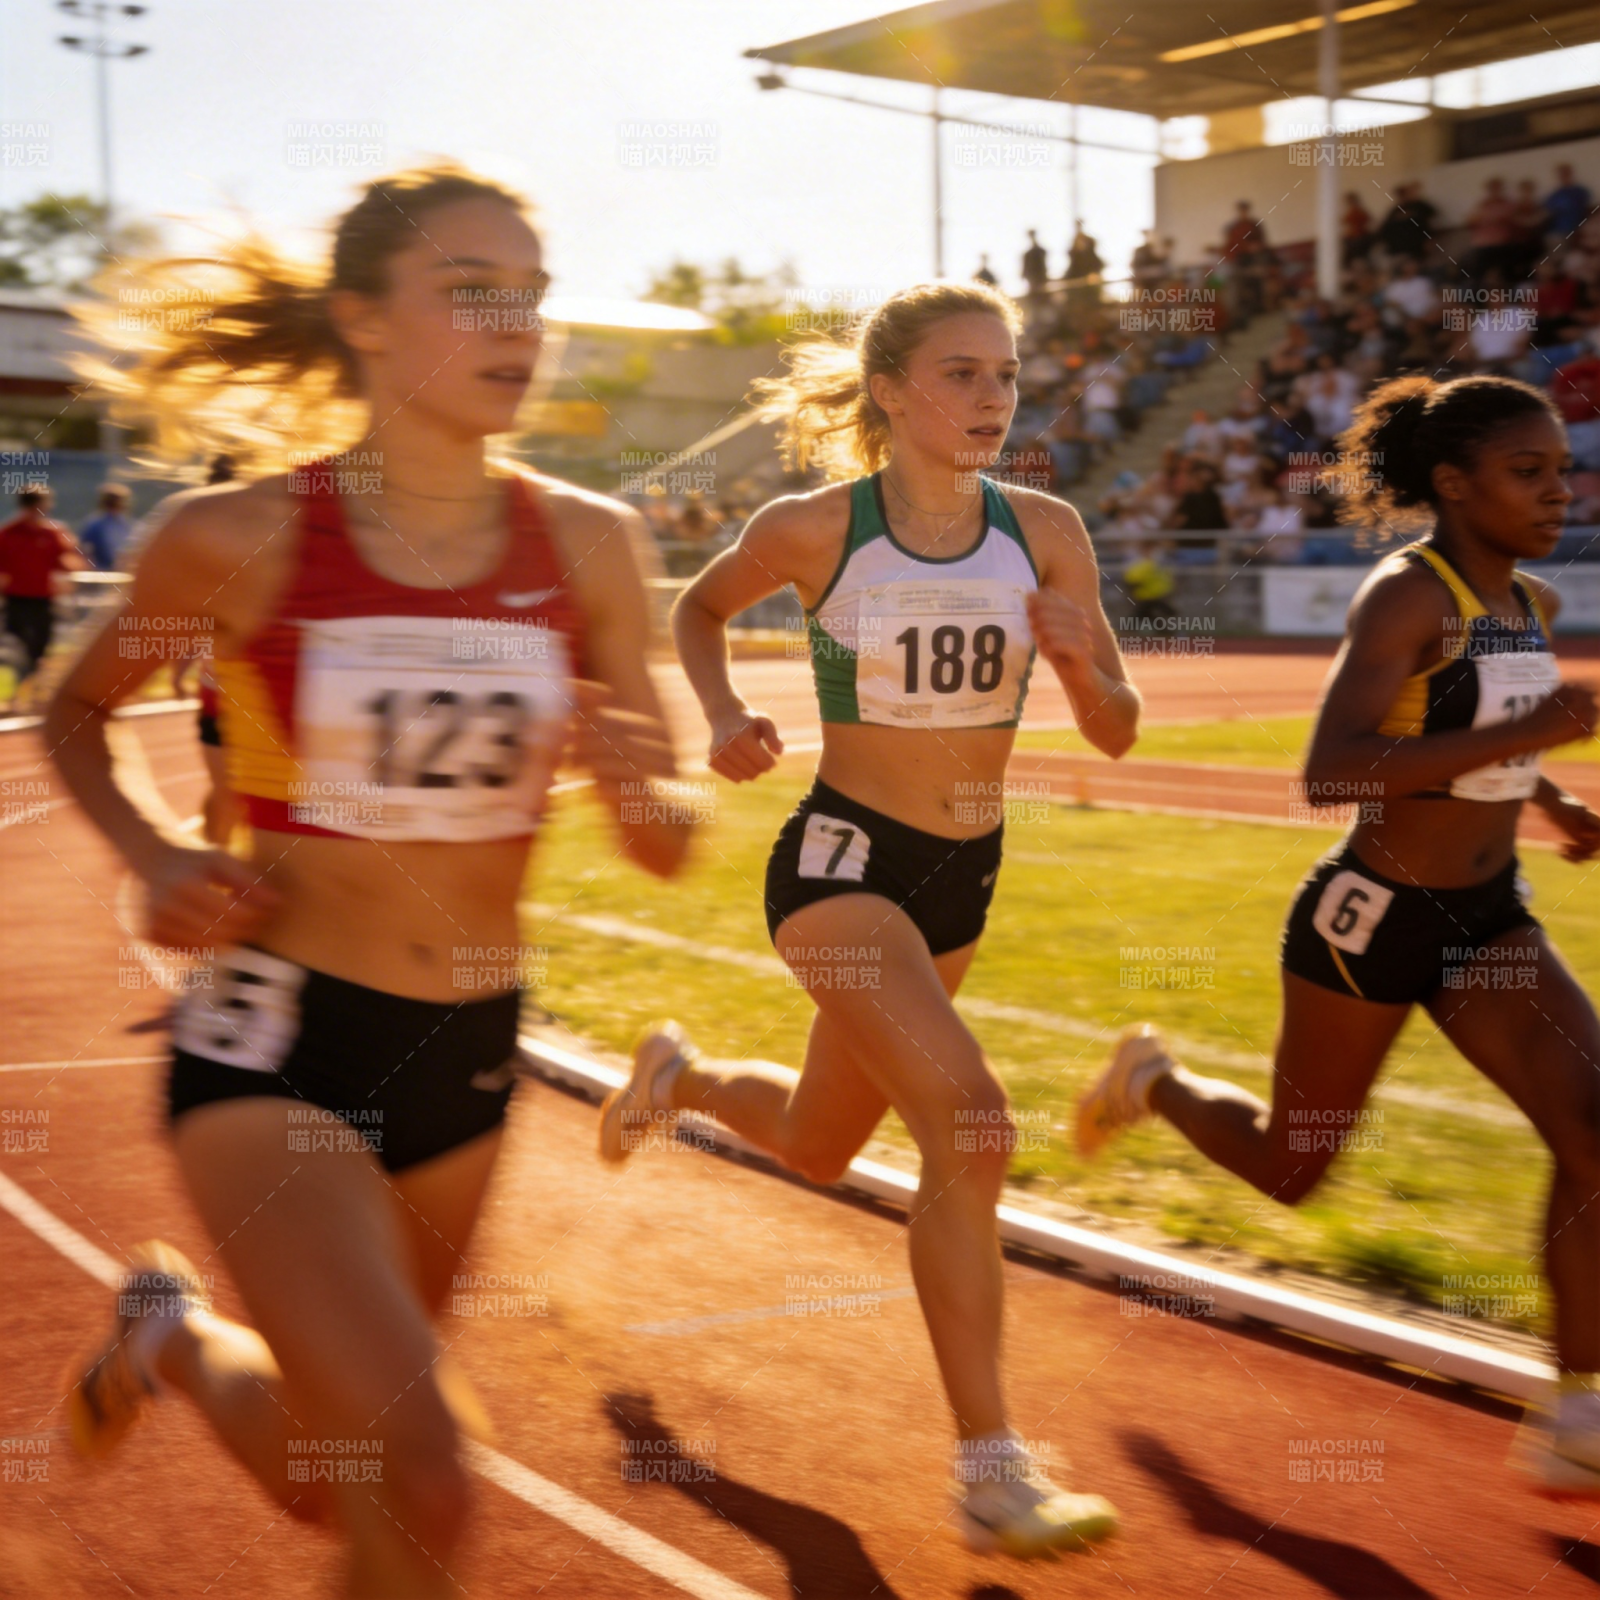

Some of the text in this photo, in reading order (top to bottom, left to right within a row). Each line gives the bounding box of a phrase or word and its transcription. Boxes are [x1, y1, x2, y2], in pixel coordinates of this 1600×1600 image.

[896, 625, 1006, 694] 188
[821, 825, 855, 876] 7
[1330, 887, 1370, 936] 6
